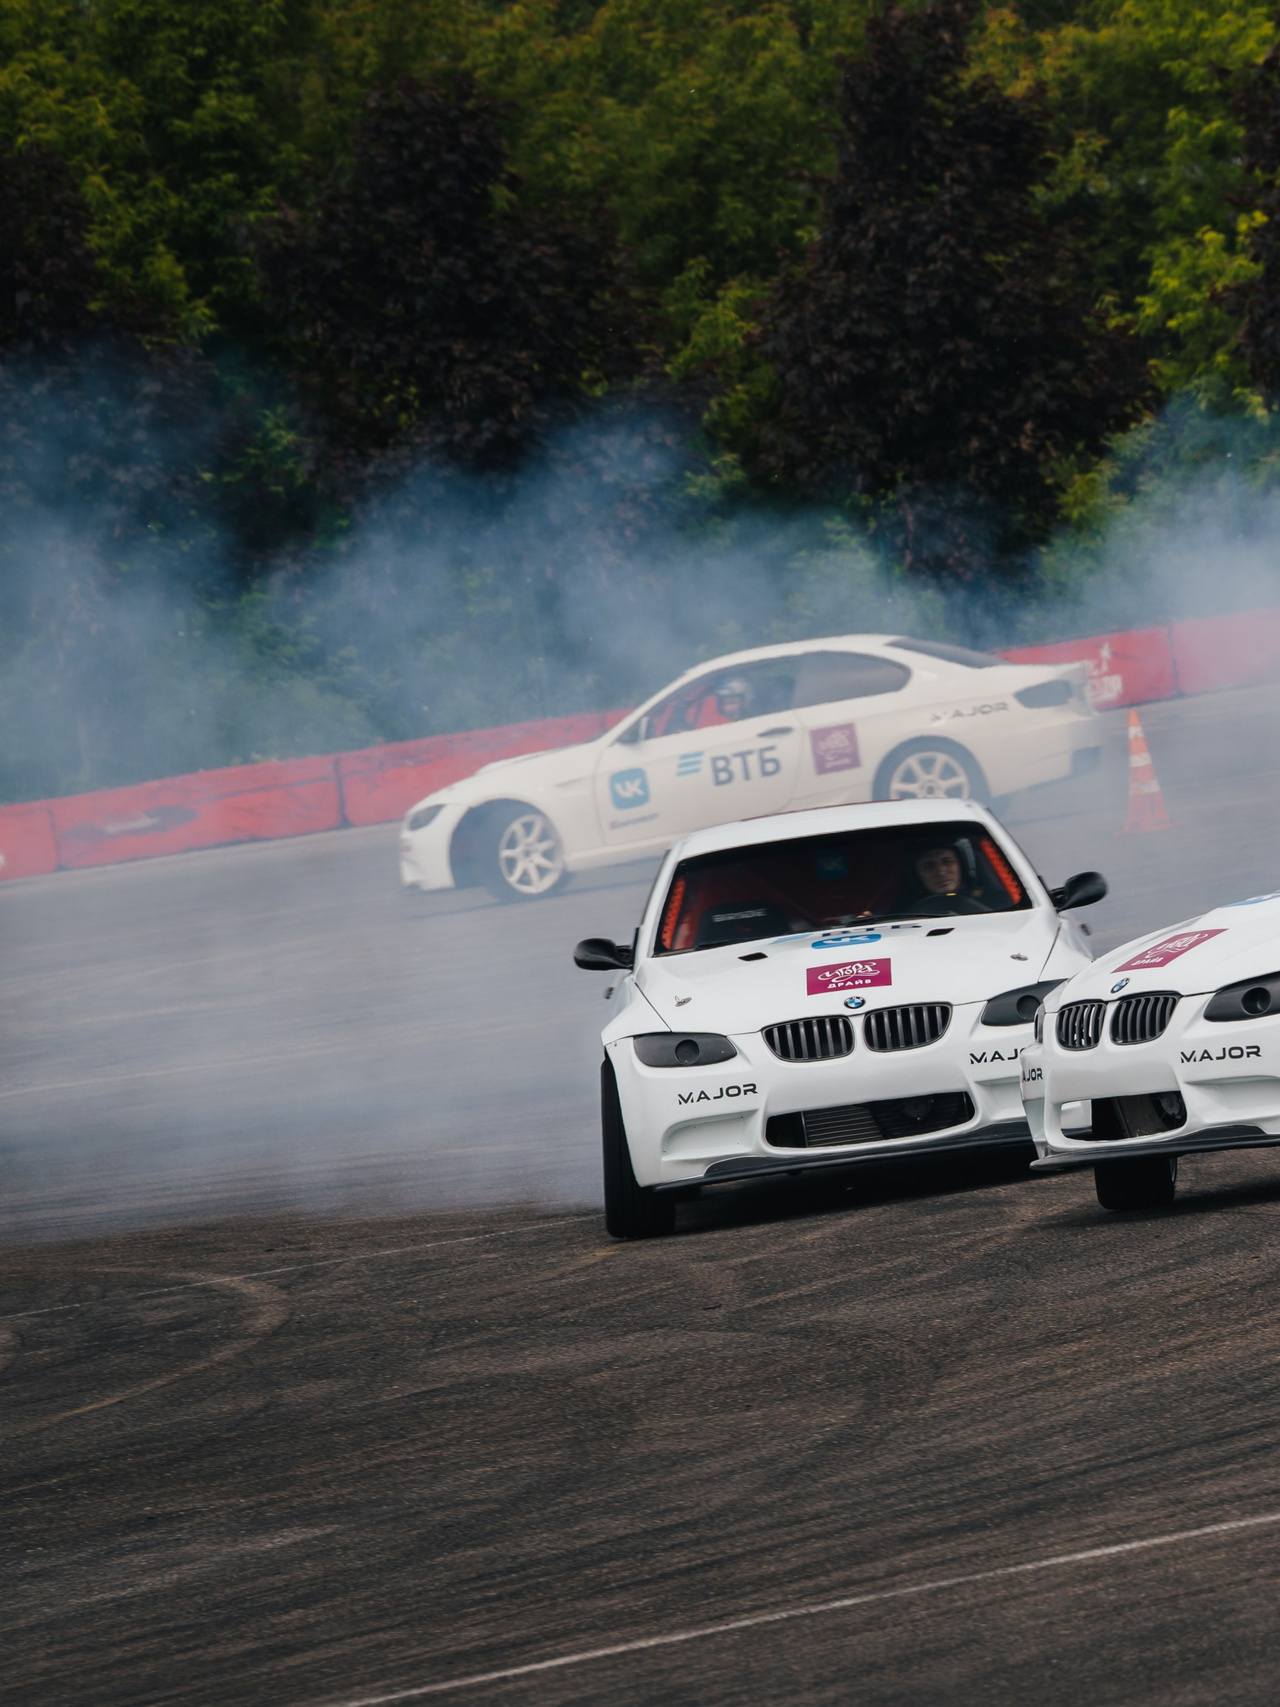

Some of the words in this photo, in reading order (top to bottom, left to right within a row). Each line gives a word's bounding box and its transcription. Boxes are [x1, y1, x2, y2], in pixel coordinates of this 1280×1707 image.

[711, 745, 782, 786] ВТБ
[614, 778, 645, 798] VK
[827, 979, 872, 989] ДРАЙВ
[970, 1047, 1025, 1064] MAJ
[1180, 1045, 1262, 1063] MAJOR
[678, 1083, 758, 1105] MAJOR
